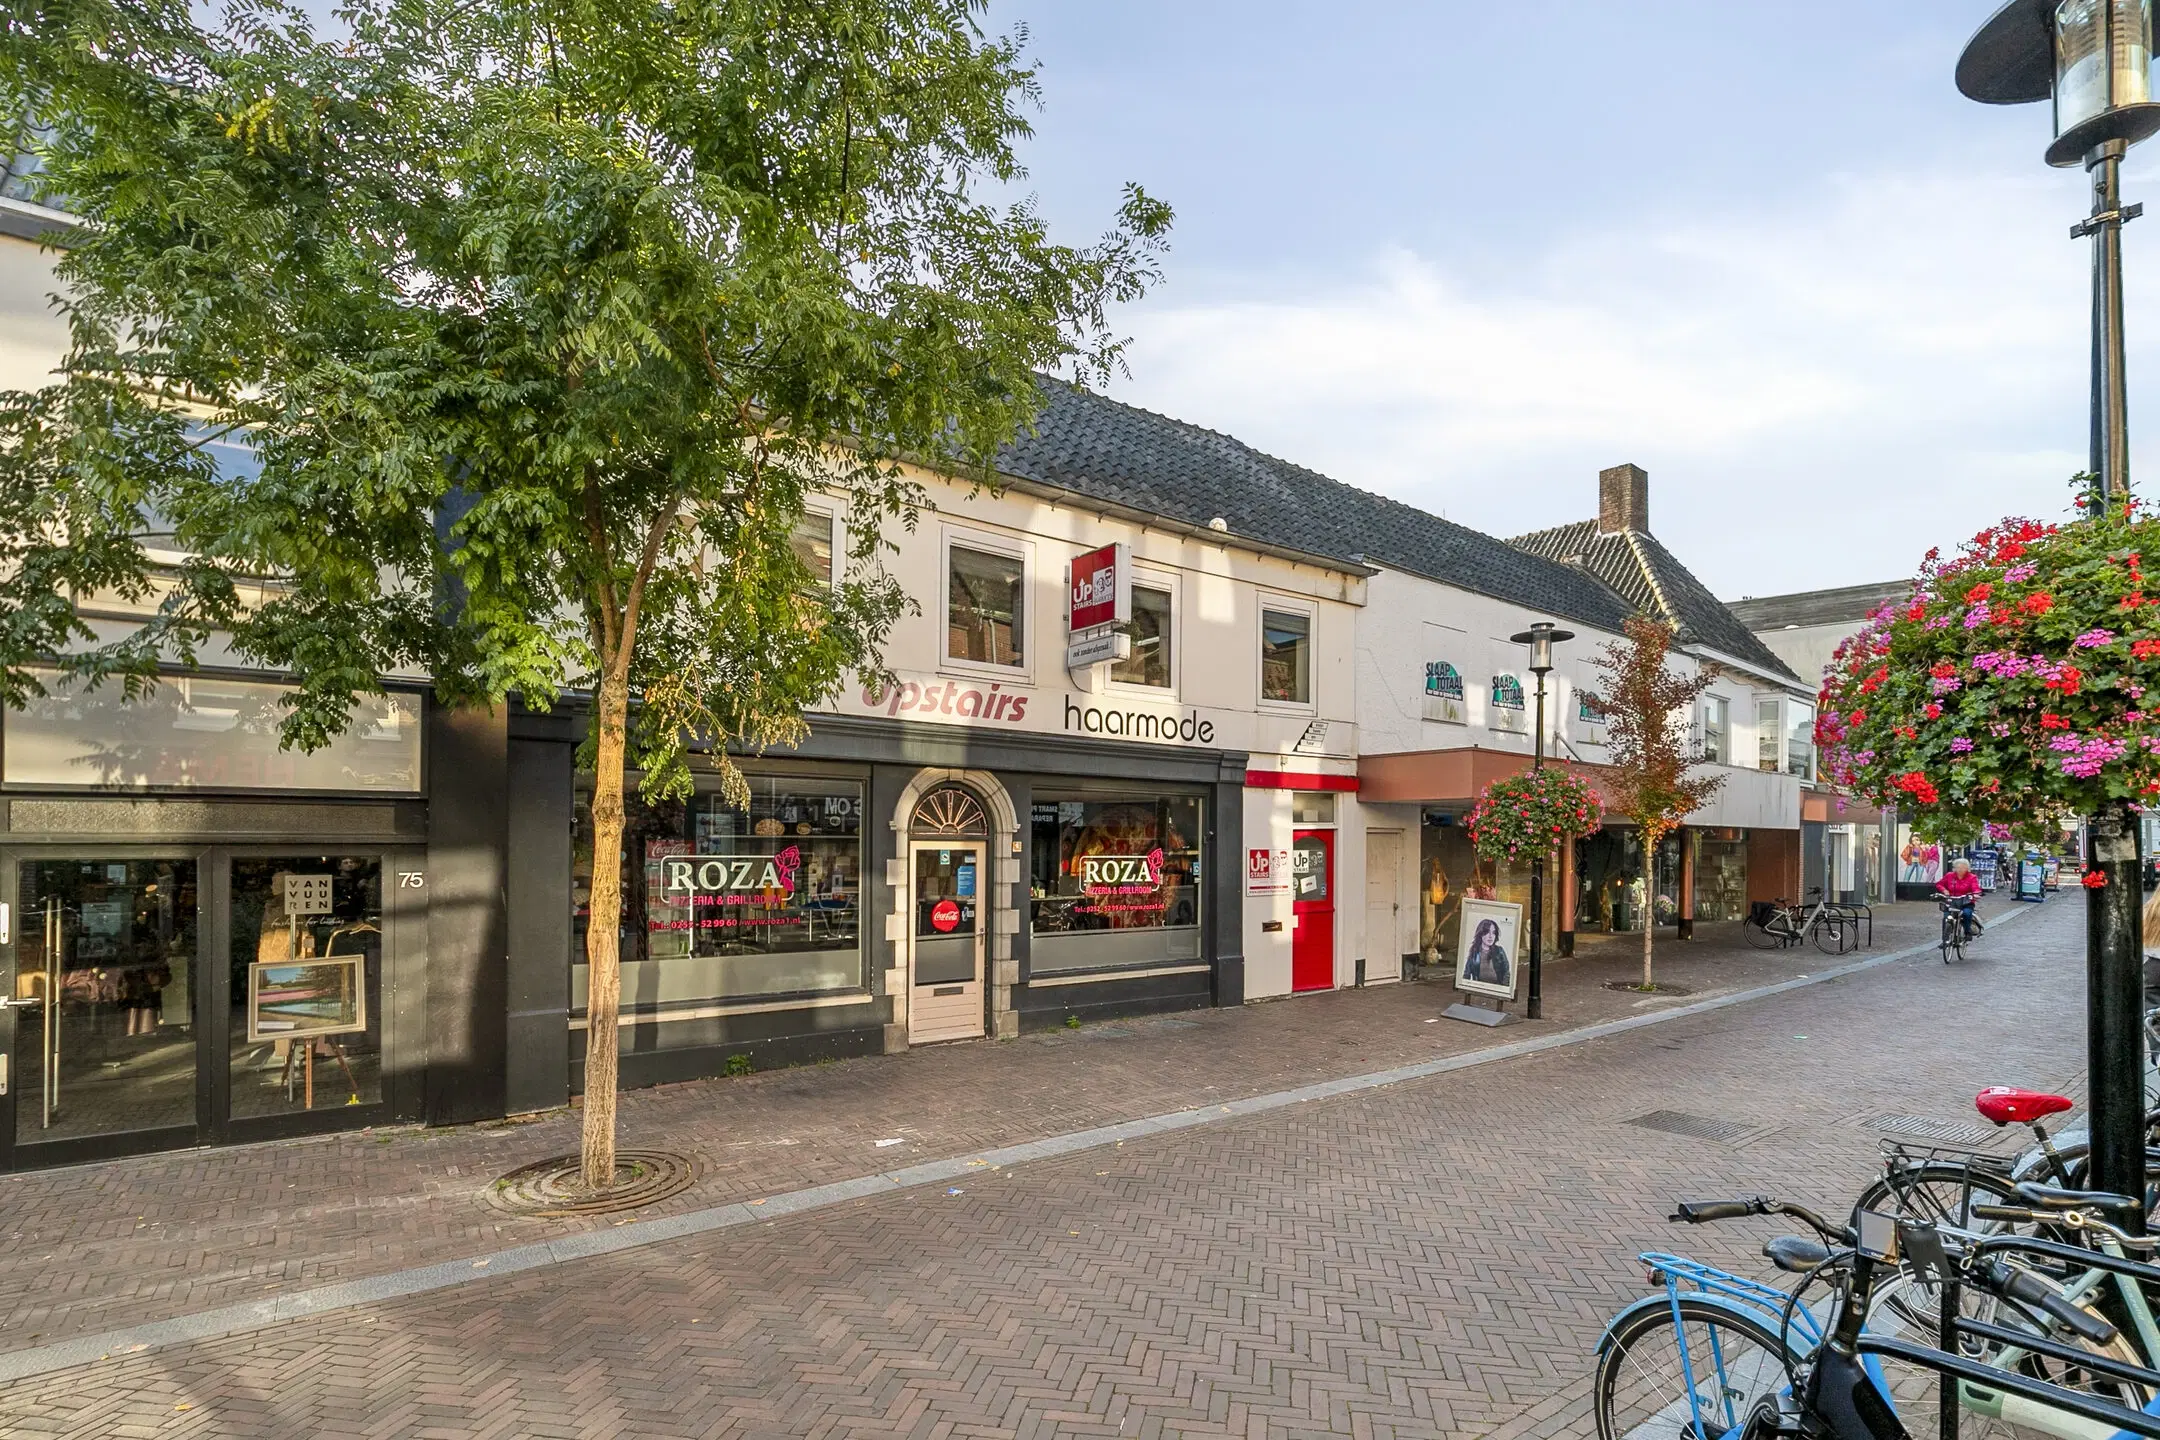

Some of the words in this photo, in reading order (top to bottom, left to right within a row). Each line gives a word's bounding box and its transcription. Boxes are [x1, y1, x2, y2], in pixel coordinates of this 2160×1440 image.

[1073, 580, 1092, 603] UP
[1073, 599, 1093, 611] STAIRS
[1426, 662, 1450, 677] SLAAP
[1436, 676, 1463, 690] TOTAAL
[1492, 675, 1513, 690] SLAAP
[1501, 687, 1524, 701] TOTAAL
[862, 681, 1028, 722] upstairs
[1064, 694, 1215, 744] haarmode
[1250, 855, 1268, 872] UP
[1294, 855, 1308, 867] UP
[667, 861, 783, 890] ROZA
[1083, 860, 1153, 883] ROZA
[289, 880, 328, 888] VAN
[398, 872, 424, 888] 75
[289, 890, 327, 899] VUU
[1085, 887, 1111, 895] PIZZERIA
[1119, 886, 1152, 894] GRILLROOM
[289, 901, 328, 910] REN
[669, 895, 714, 906] PIZZERIA
[716, 895, 724, 905] &
[727, 894, 782, 905] GRILLROOM
[271, 917, 304, 928] fashon
[305, 916, 318, 927] for
[701, 920, 713, 928] 52
[713, 919, 726, 928] 99
[727, 919, 737, 927] 60
[743, 916, 801, 926] www.roza1.nl
